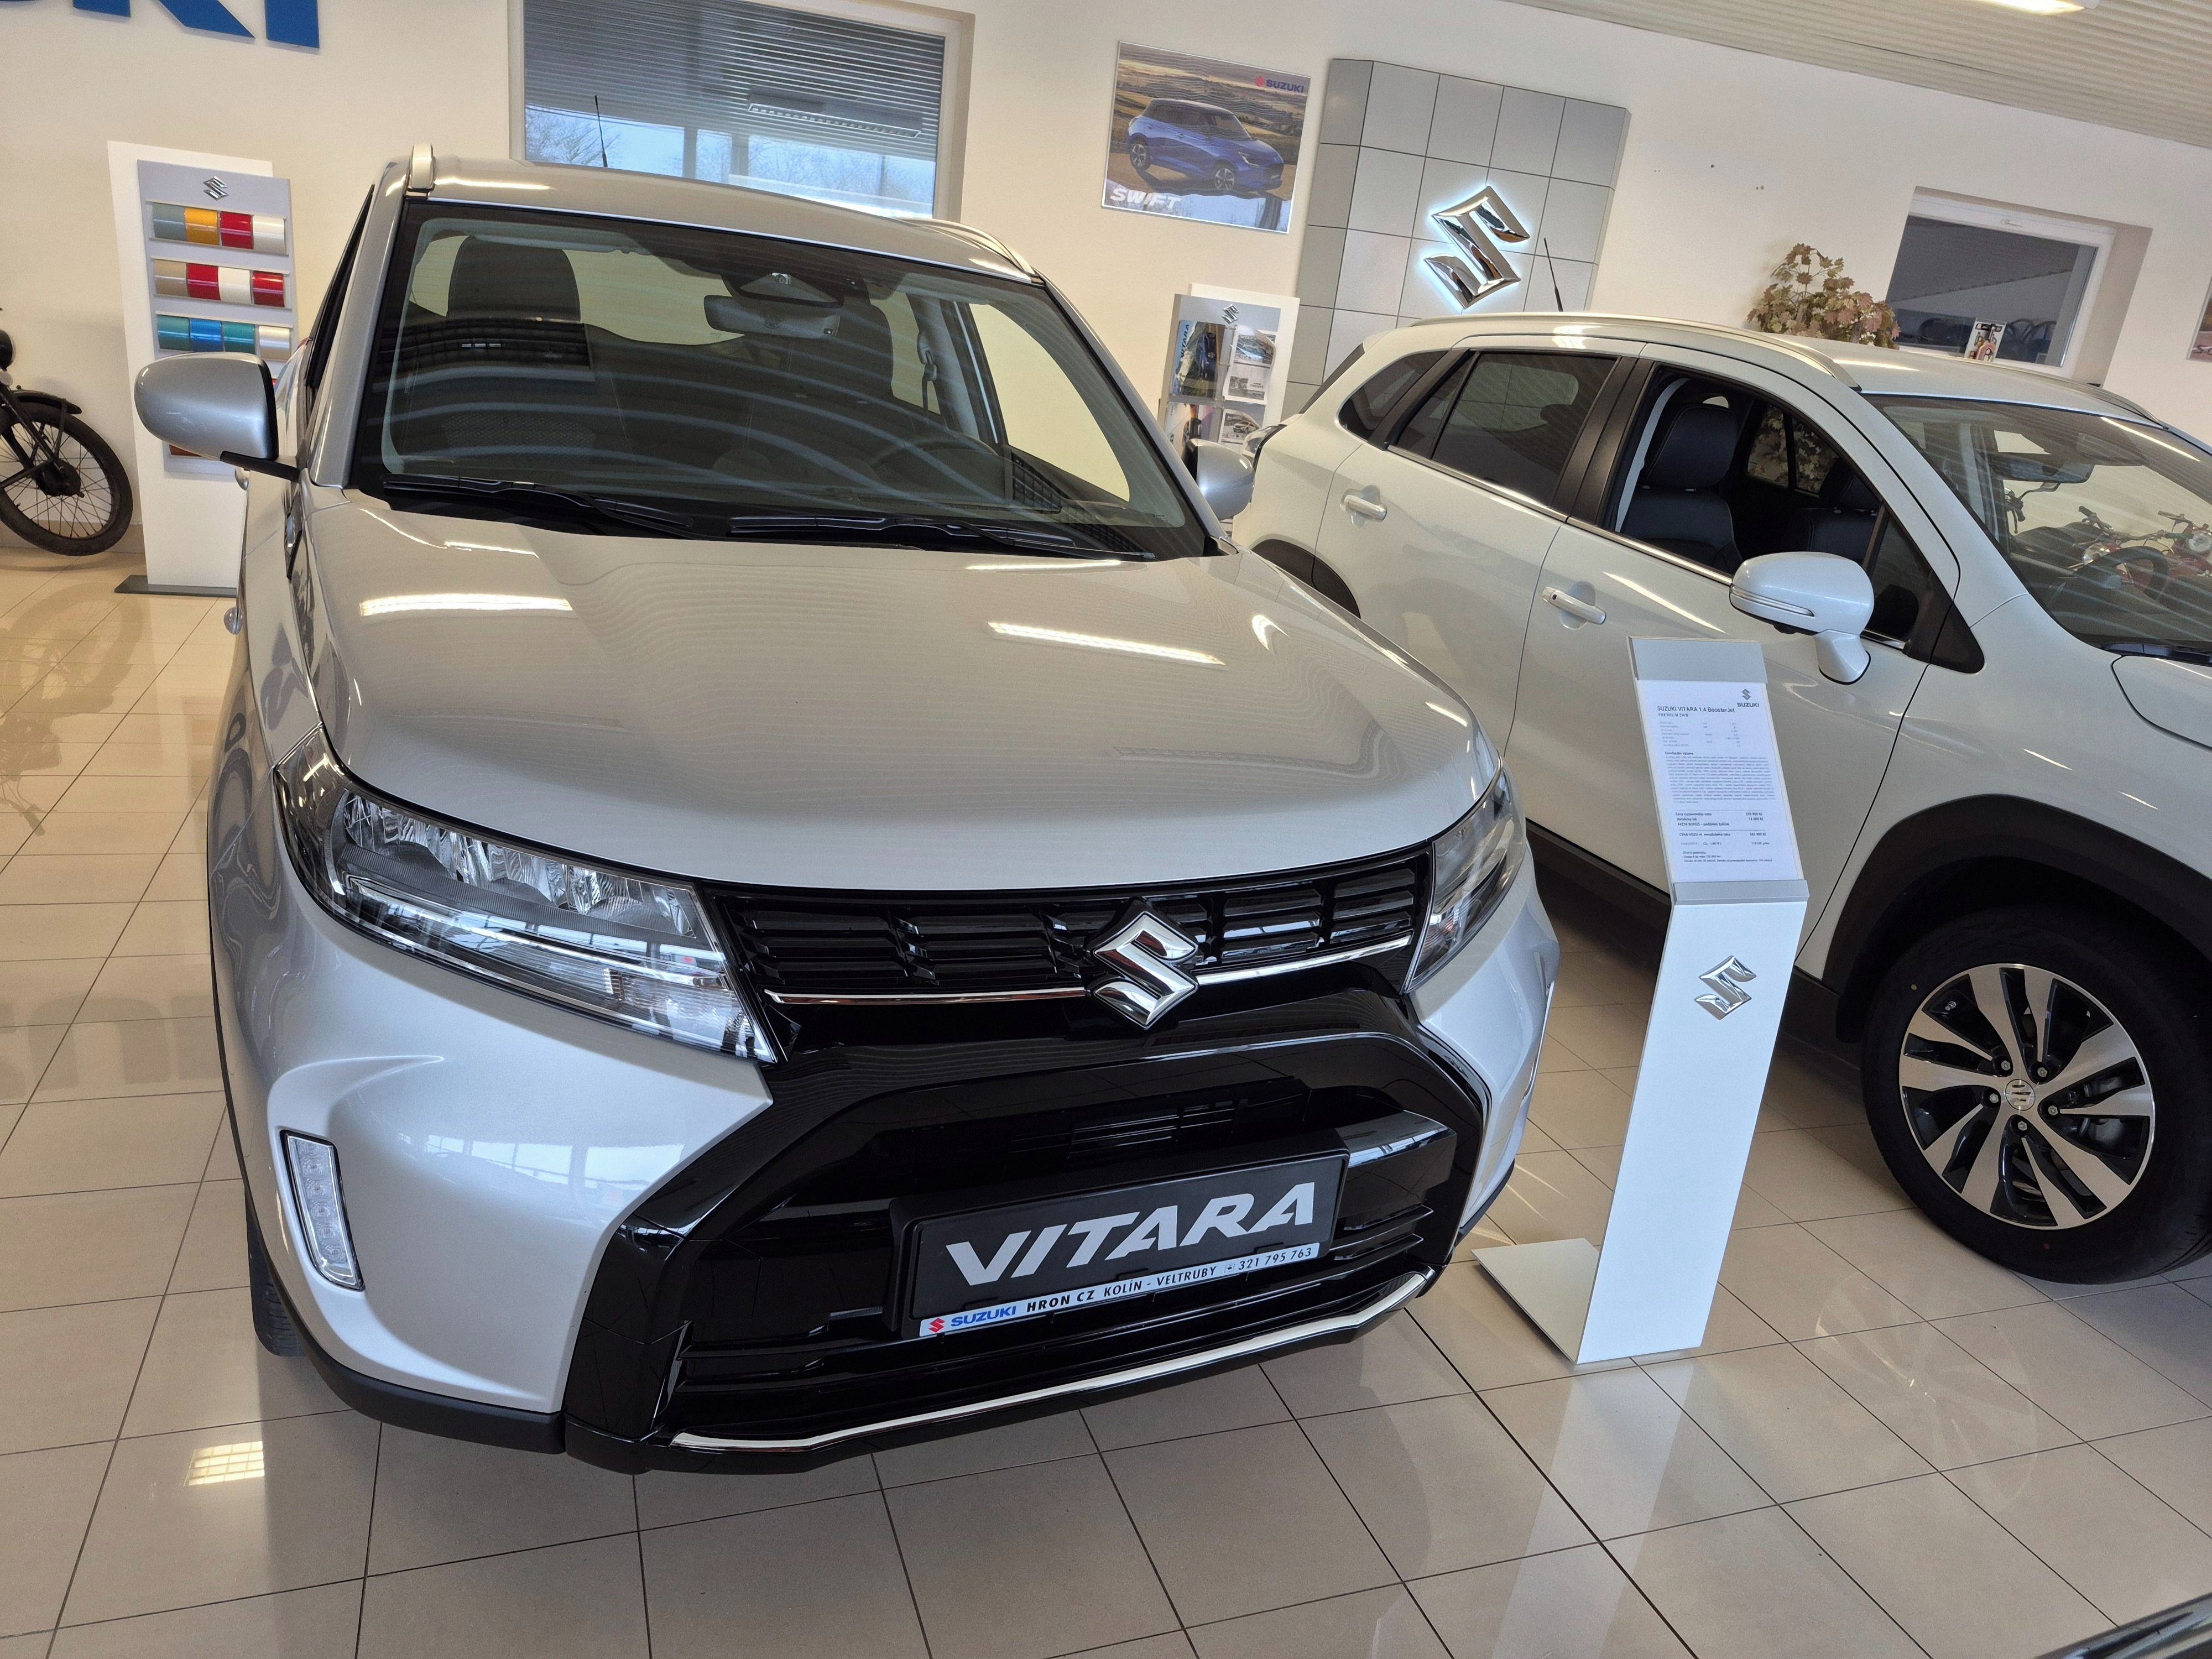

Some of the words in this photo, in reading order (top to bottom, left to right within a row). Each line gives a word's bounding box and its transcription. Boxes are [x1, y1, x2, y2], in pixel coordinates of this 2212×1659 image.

[1266, 79, 1305, 93] SUZUKI
[1110, 188, 1182, 209] SWIFT
[946, 1182, 1314, 1286] VITARA
[951, 1306, 1016, 1327] SUZUKI
[1026, 1295, 1071, 1312] HRON
[1077, 1290, 1095, 1302] CZ
[1104, 1280, 1142, 1297] KOLÍN
[1157, 1266, 1217, 1287] VELTRUBY
[1238, 1257, 1260, 1270] 321
[1265, 1252, 1286, 1265] 795
[1291, 1248, 1312, 1260] 763
